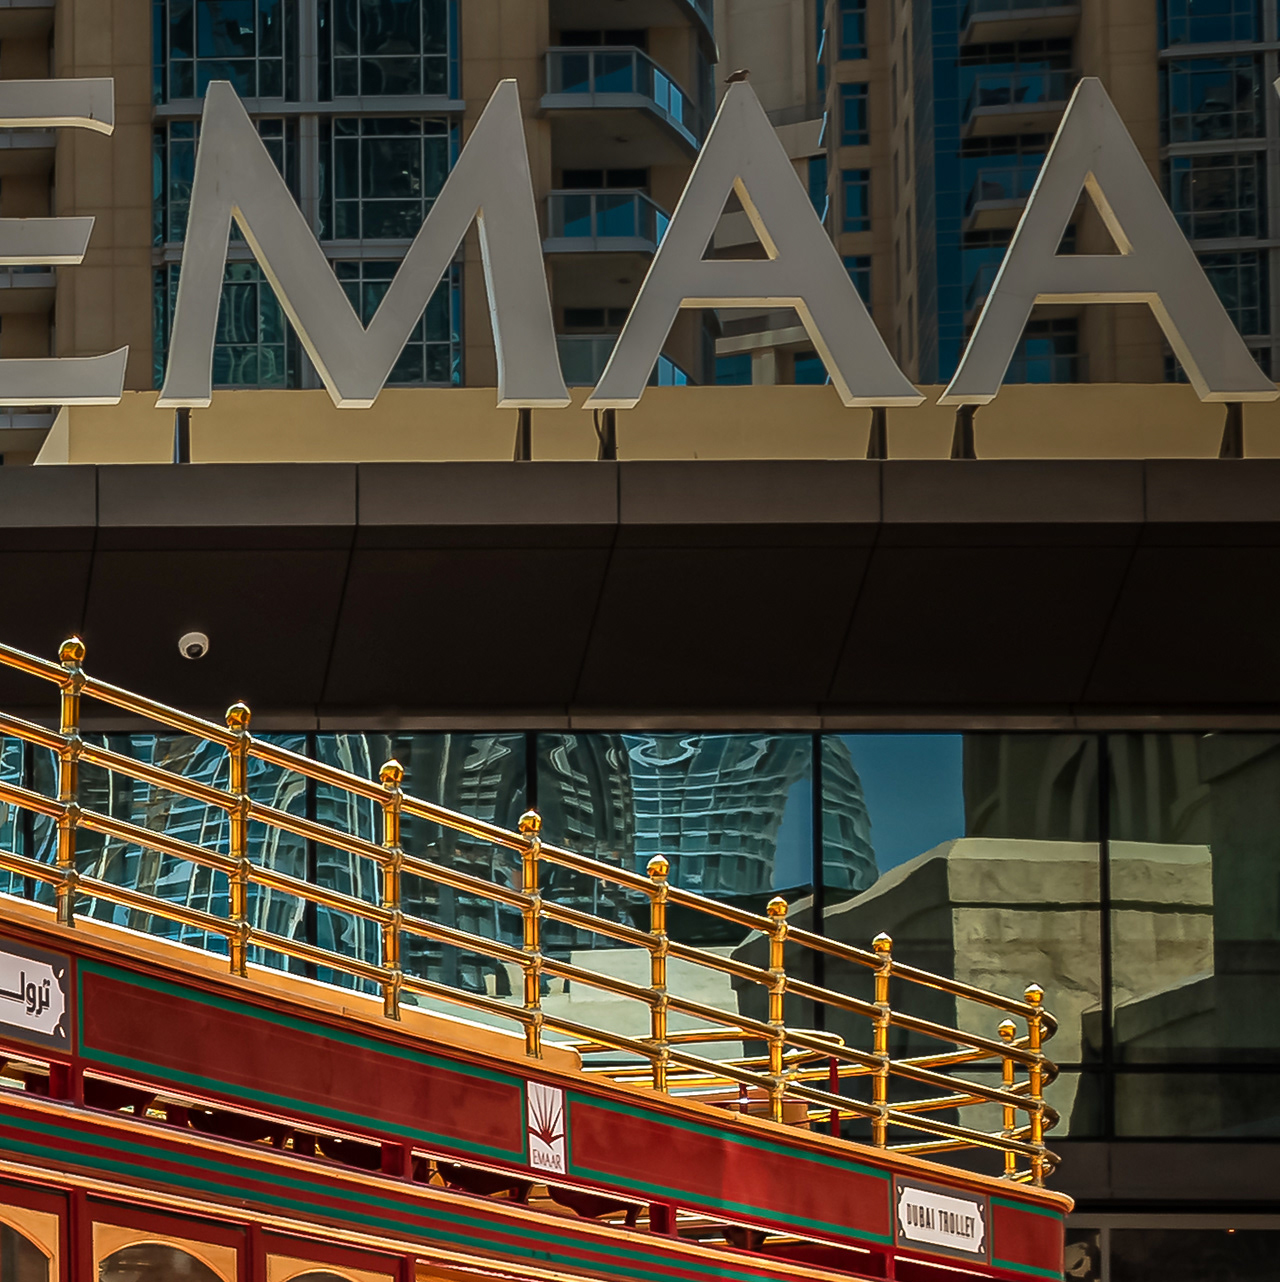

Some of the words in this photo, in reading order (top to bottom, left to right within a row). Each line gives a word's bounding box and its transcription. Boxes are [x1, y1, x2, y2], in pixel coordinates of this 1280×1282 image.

[532, 1148, 563, 1170] EMAAR
[906, 1202, 935, 1230] DUBAI
[938, 1209, 976, 1239] TROLLEY
